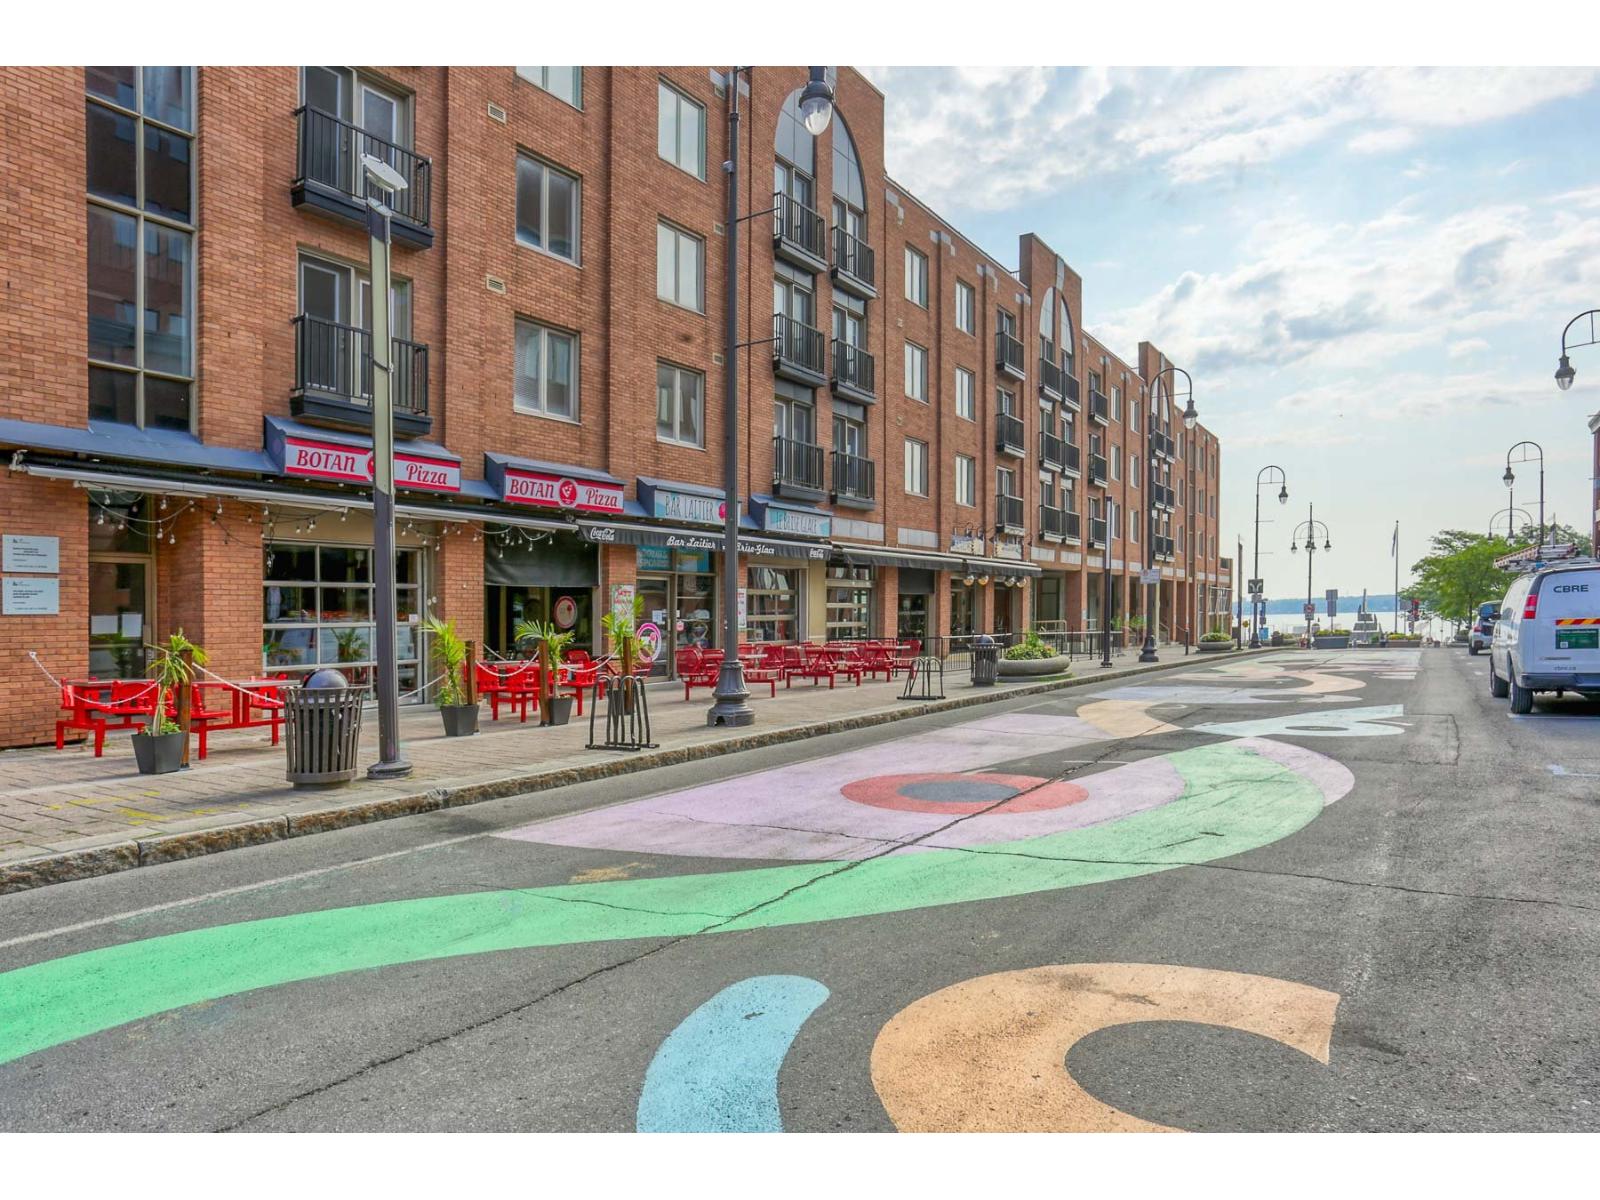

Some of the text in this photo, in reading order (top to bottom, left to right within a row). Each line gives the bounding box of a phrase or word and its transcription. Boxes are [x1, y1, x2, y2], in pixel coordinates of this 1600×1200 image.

[405, 463, 448, 485] Pizza
[586, 487, 618, 507] Pizza
[665, 495, 714, 521] BAR LAITIER
[666, 535, 685, 546] Bar
[686, 537, 716, 549] Laitier
[1553, 584, 1589, 593] CBRE
